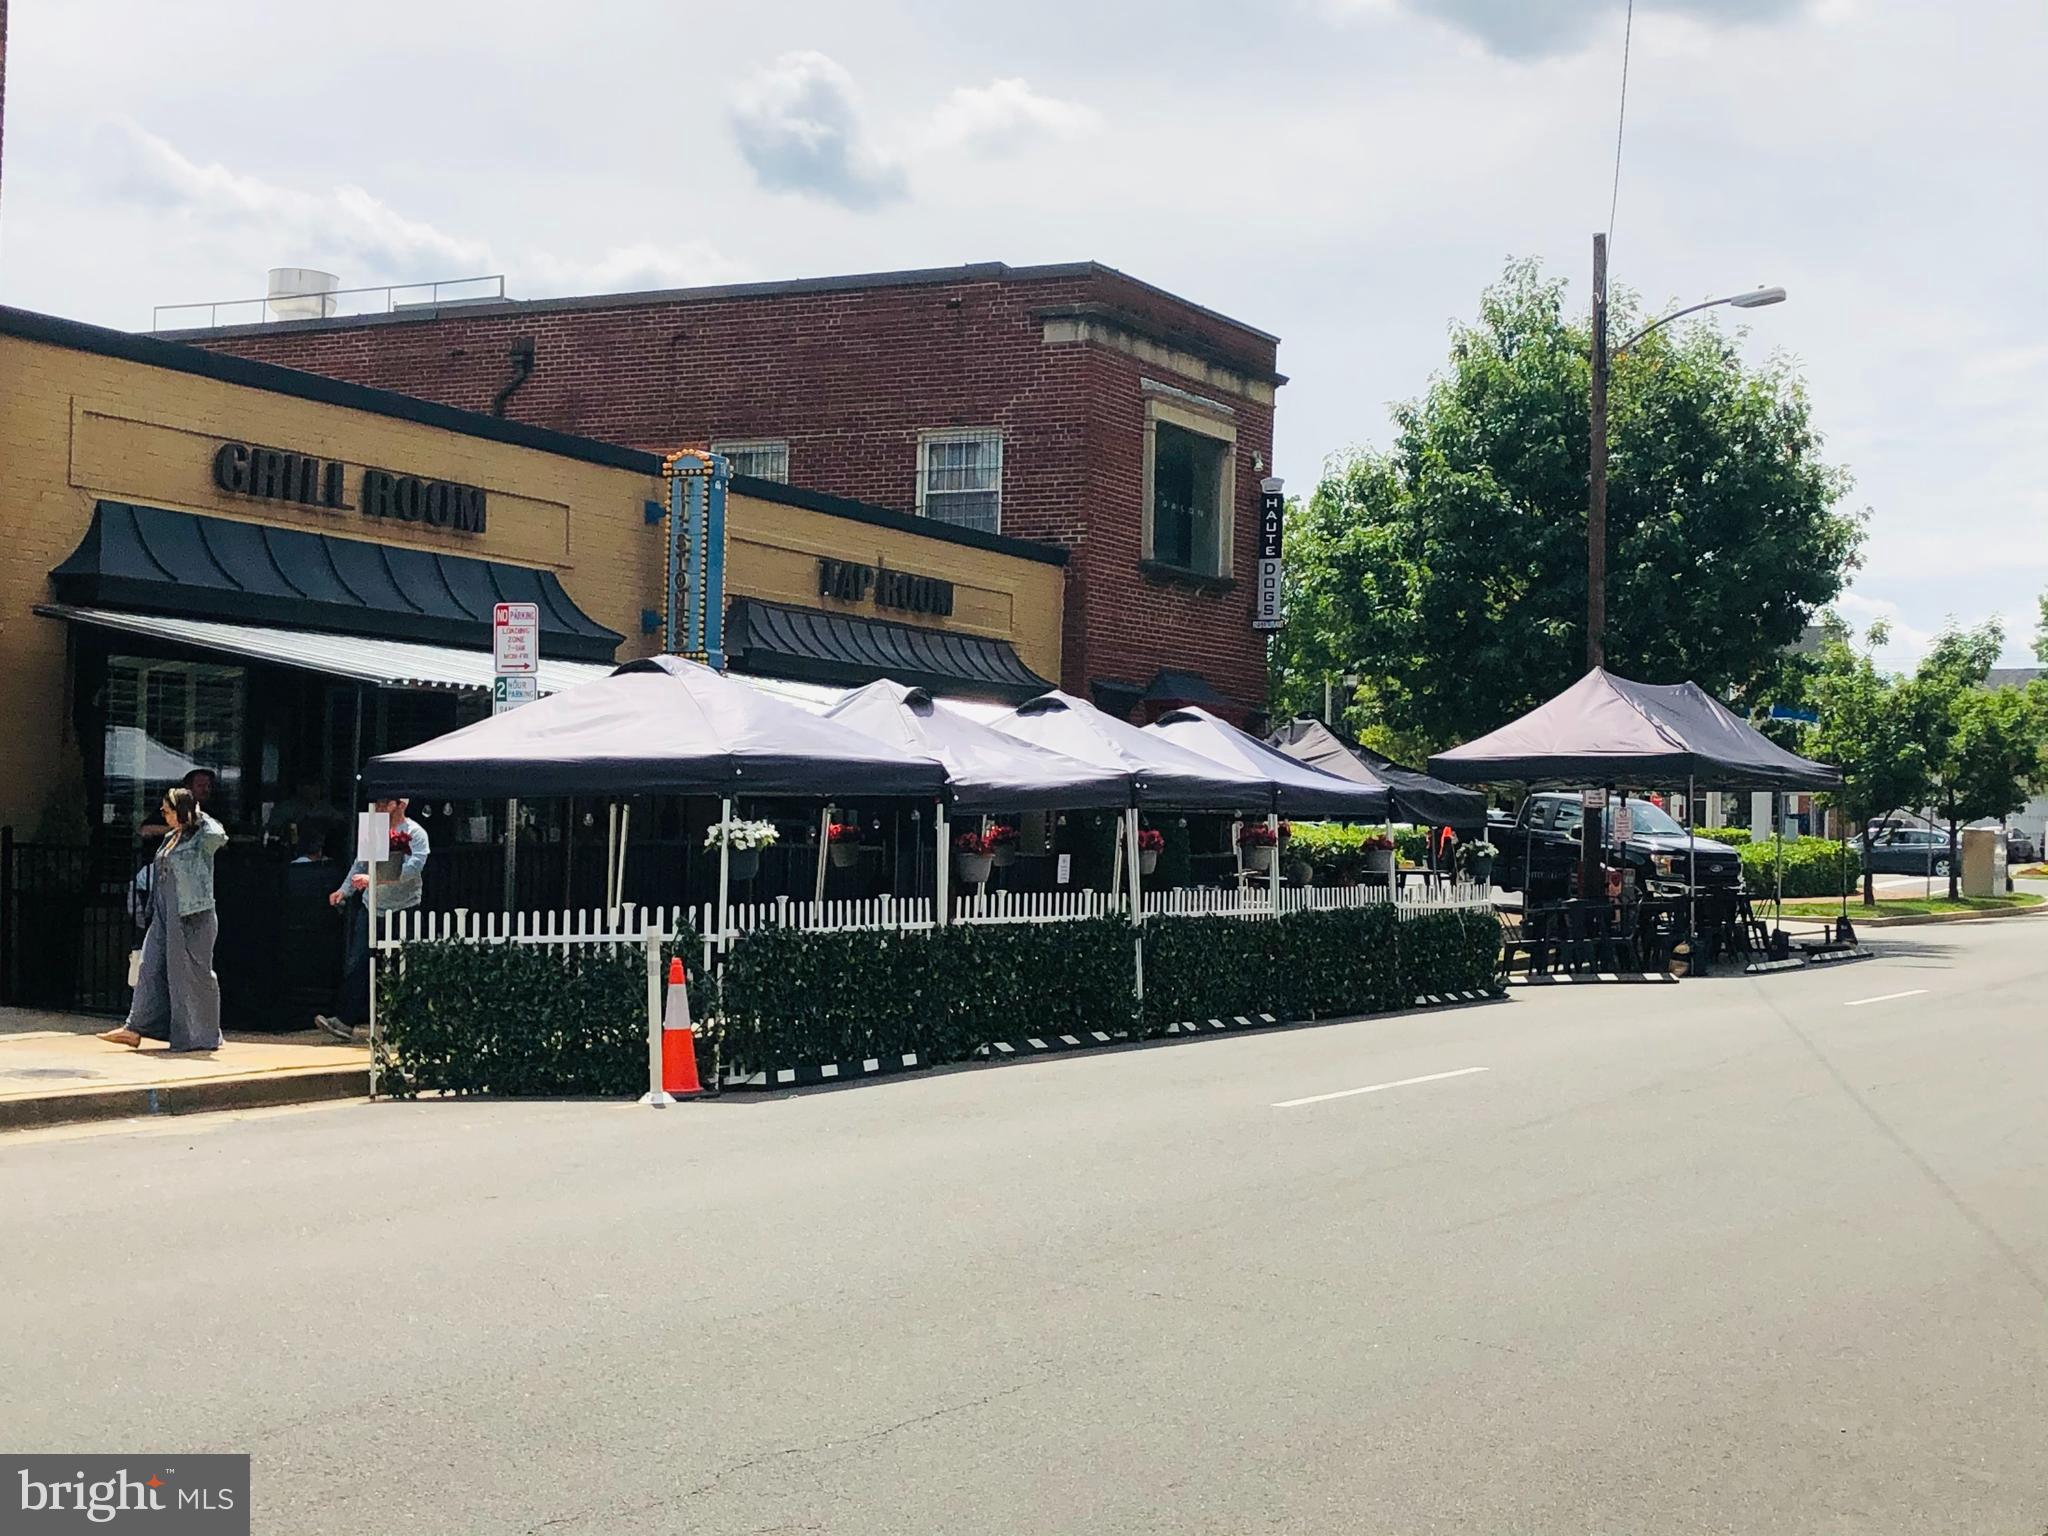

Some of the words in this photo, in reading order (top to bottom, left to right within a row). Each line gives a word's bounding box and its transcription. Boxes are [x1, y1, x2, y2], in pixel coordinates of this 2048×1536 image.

[213, 443, 354, 510] GRILL
[362, 469, 486, 533] ROOM
[1265, 498, 1278, 556] HAUTE
[818, 558, 877, 602] TAP
[876, 568, 954, 617] ROOM
[1263, 562, 1276, 616] DOGS
[497, 608, 508, 622] NO
[510, 611, 535, 620] PARKING
[497, 681, 506, 698] 2
[508, 680, 527, 689] HOUR
[508, 690, 534, 699] PARKING
